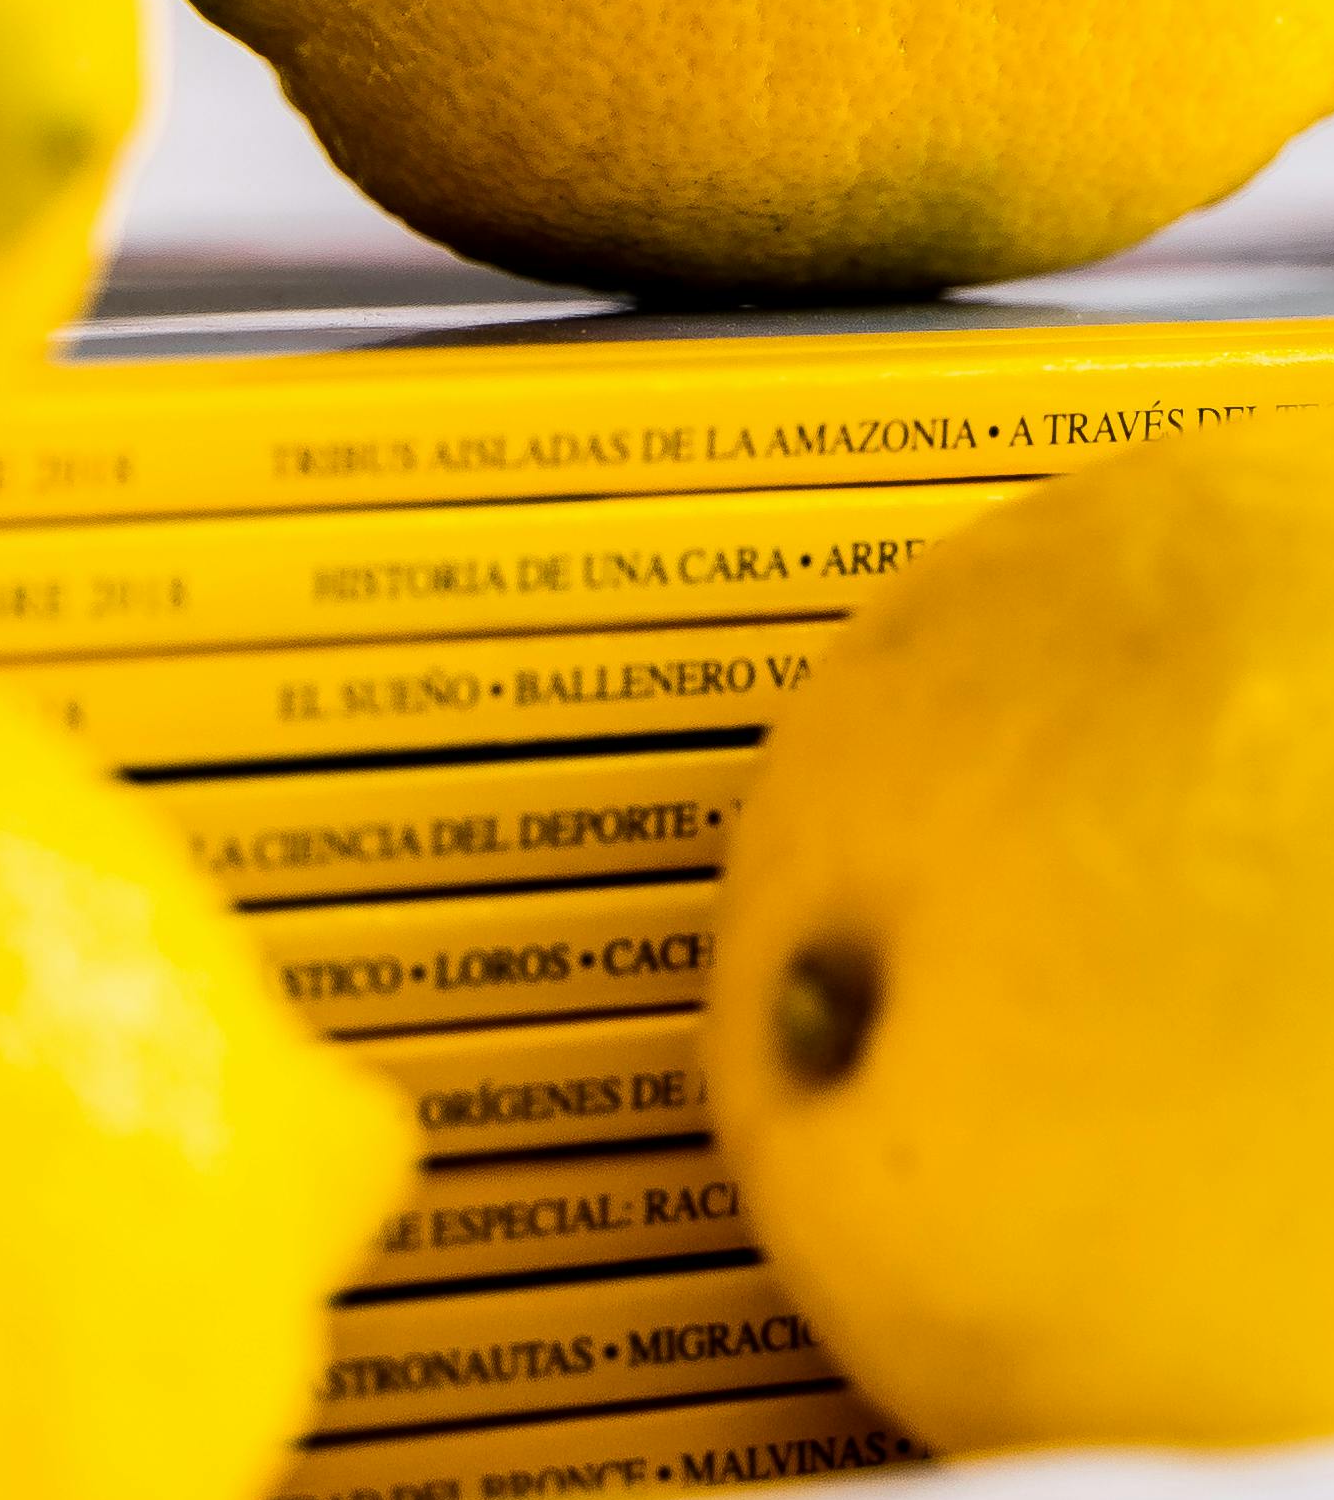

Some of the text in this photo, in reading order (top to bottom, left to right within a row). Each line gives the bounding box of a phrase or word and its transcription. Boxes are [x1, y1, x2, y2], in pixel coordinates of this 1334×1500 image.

[272, 438, 417, 479] TRIBUS
[431, 430, 628, 472] AISLADAS
[642, 425, 694, 464] DE
[707, 425, 756, 461] LA
[767, 418, 977, 457] AMAZONIA
[1009, 415, 1034, 446] A
[1043, 400, 1184, 444] TRAVÉS
[311, 558, 507, 603] HISTORIA
[517, 553, 571, 594] DE
[583, 550, 669, 591] UNA
[677, 544, 790, 585] CARA
[276, 680, 322, 721] EL
[342, 666, 482, 717] SUEÑO
[512, 657, 756, 708] BALLENERO
[251, 820, 423, 872] CIENCIA
[431, 814, 509, 860] DEL
[519, 801, 699, 849] DEPORTE
[434, 941, 571, 990] LOROS
[417, 1076, 621, 1131] ORÍGENES
[630, 1070, 686, 1111] DE
[430, 1194, 632, 1249] ESPECIAL:
[313, 1336, 593, 1400] STRONAUTAS
[680, 1432, 887, 1486] MALVINAS
